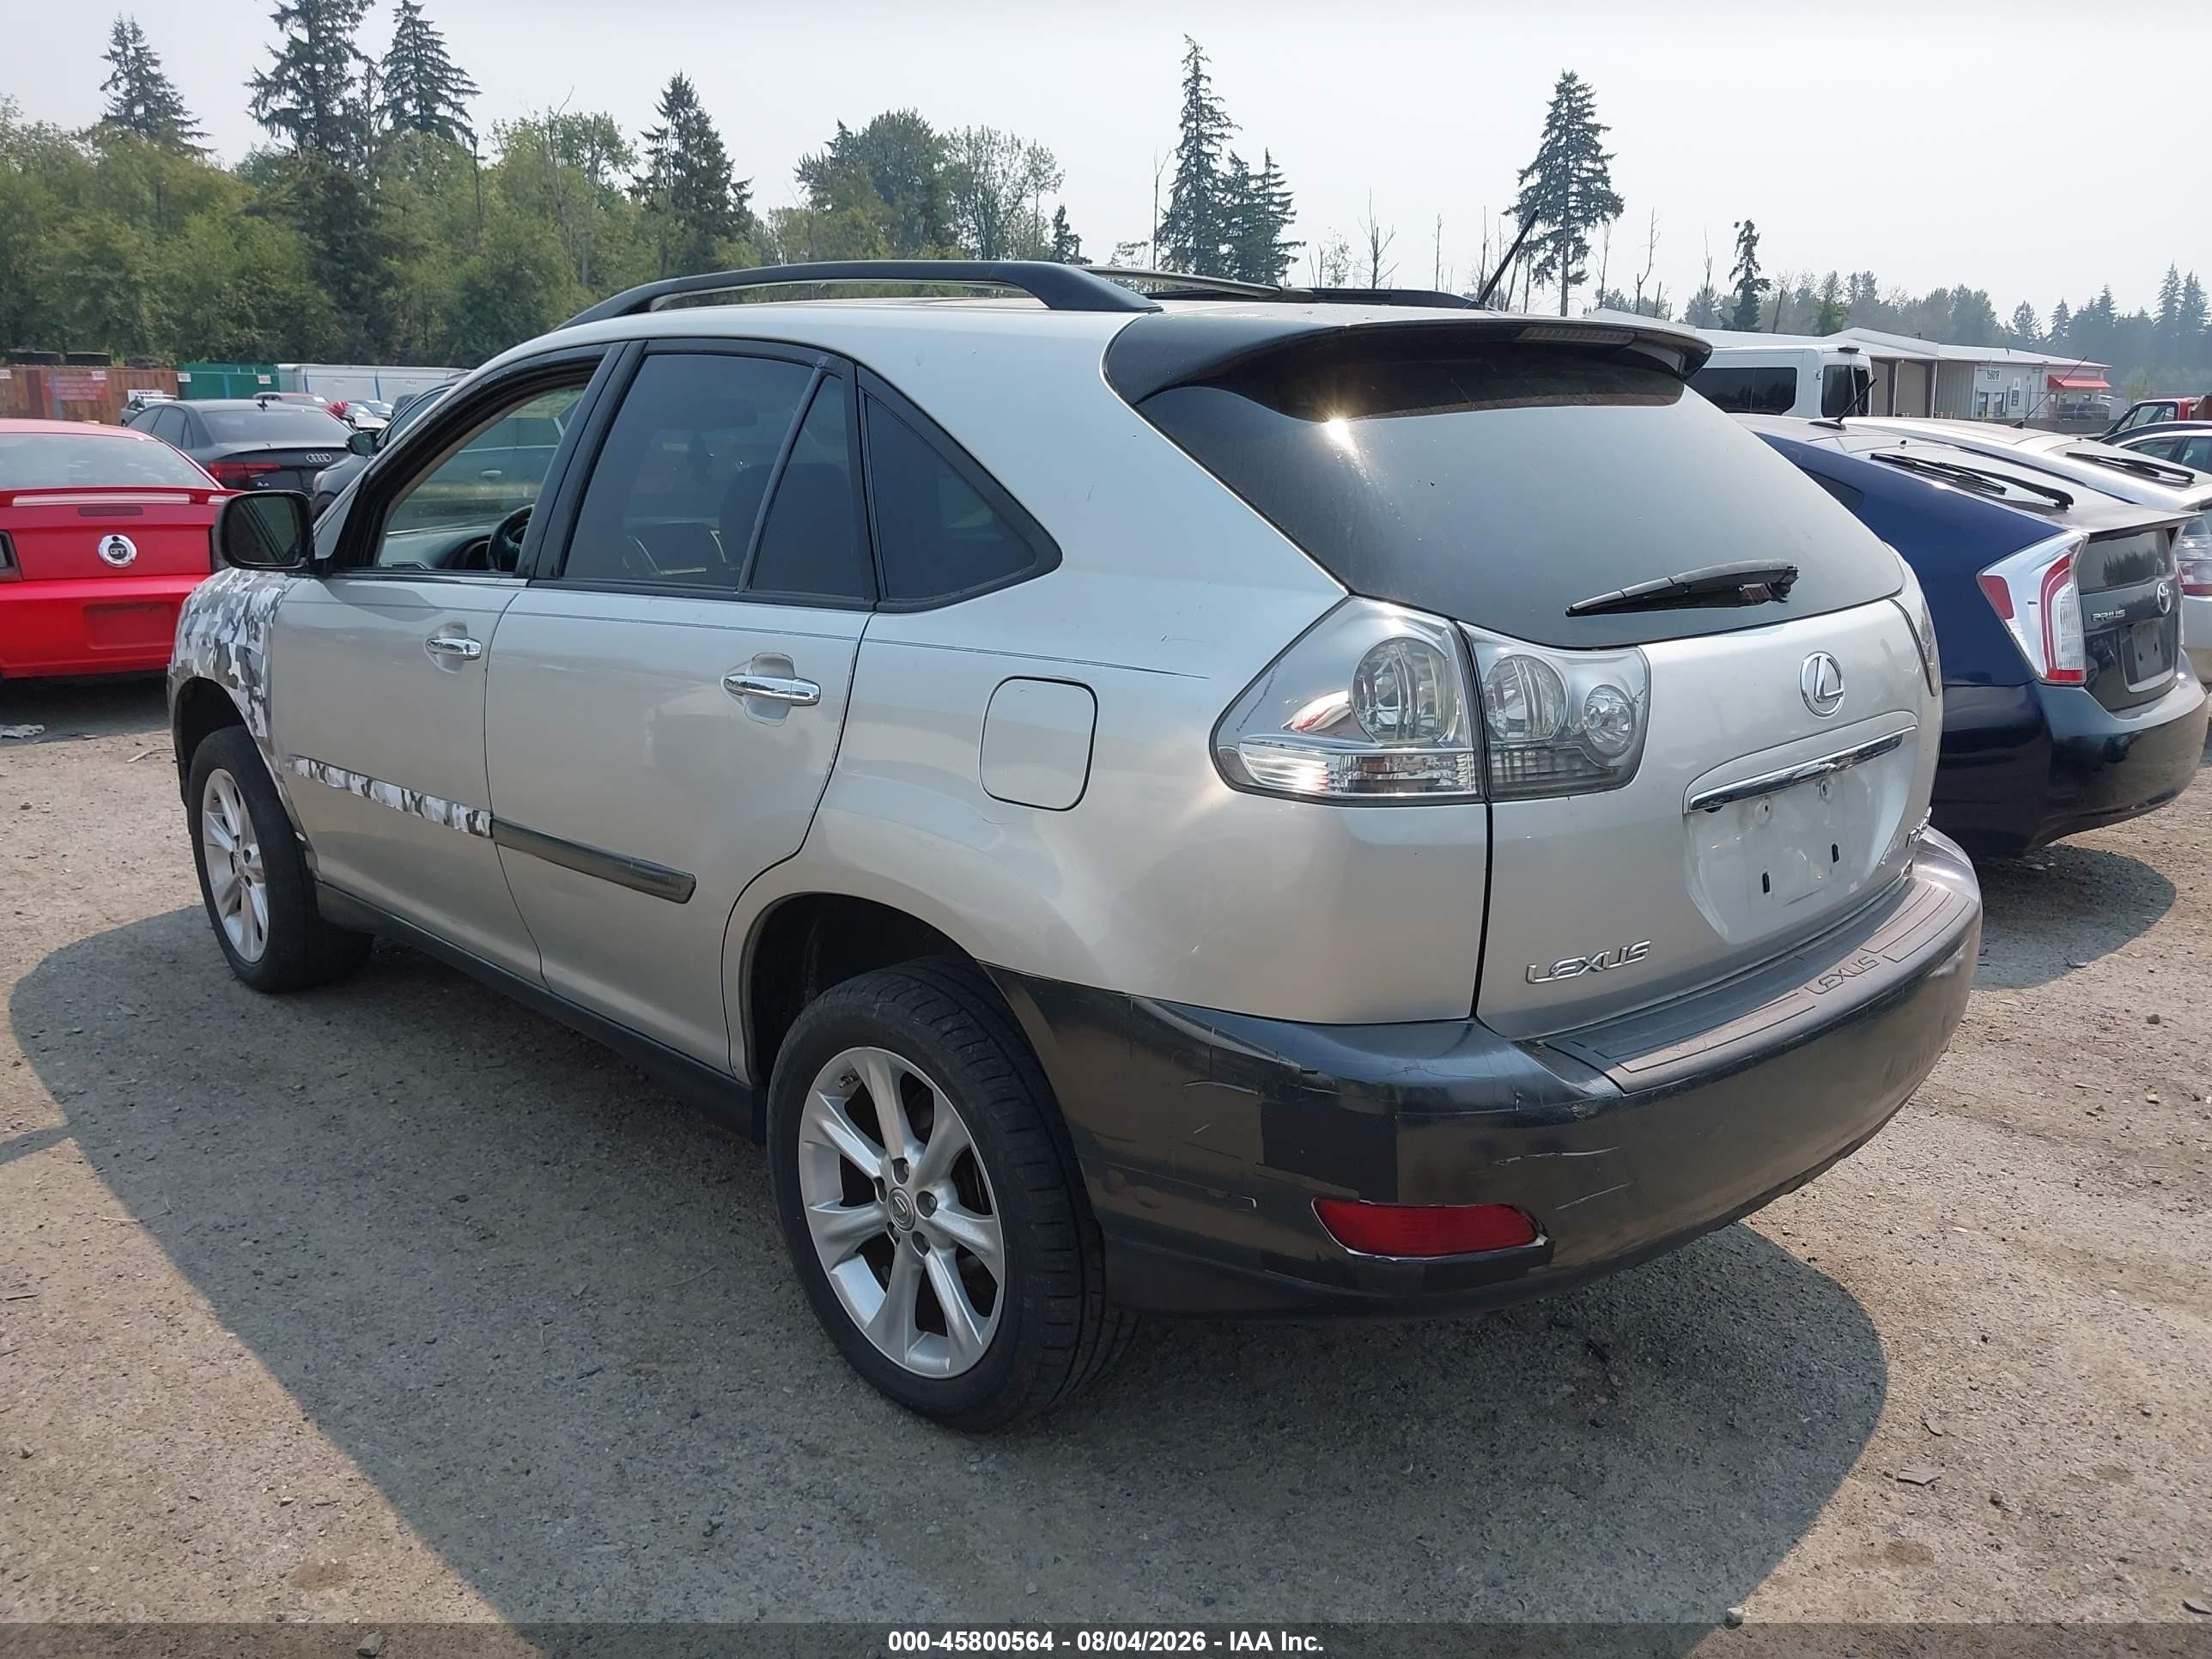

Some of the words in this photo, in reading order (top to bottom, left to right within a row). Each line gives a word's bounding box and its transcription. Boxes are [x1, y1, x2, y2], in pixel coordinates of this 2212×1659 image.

[2092, 610, 2126, 622] PRIUS
[1526, 939, 1651, 984] LEXUS
[1803, 956, 1881, 995] LEXUS
